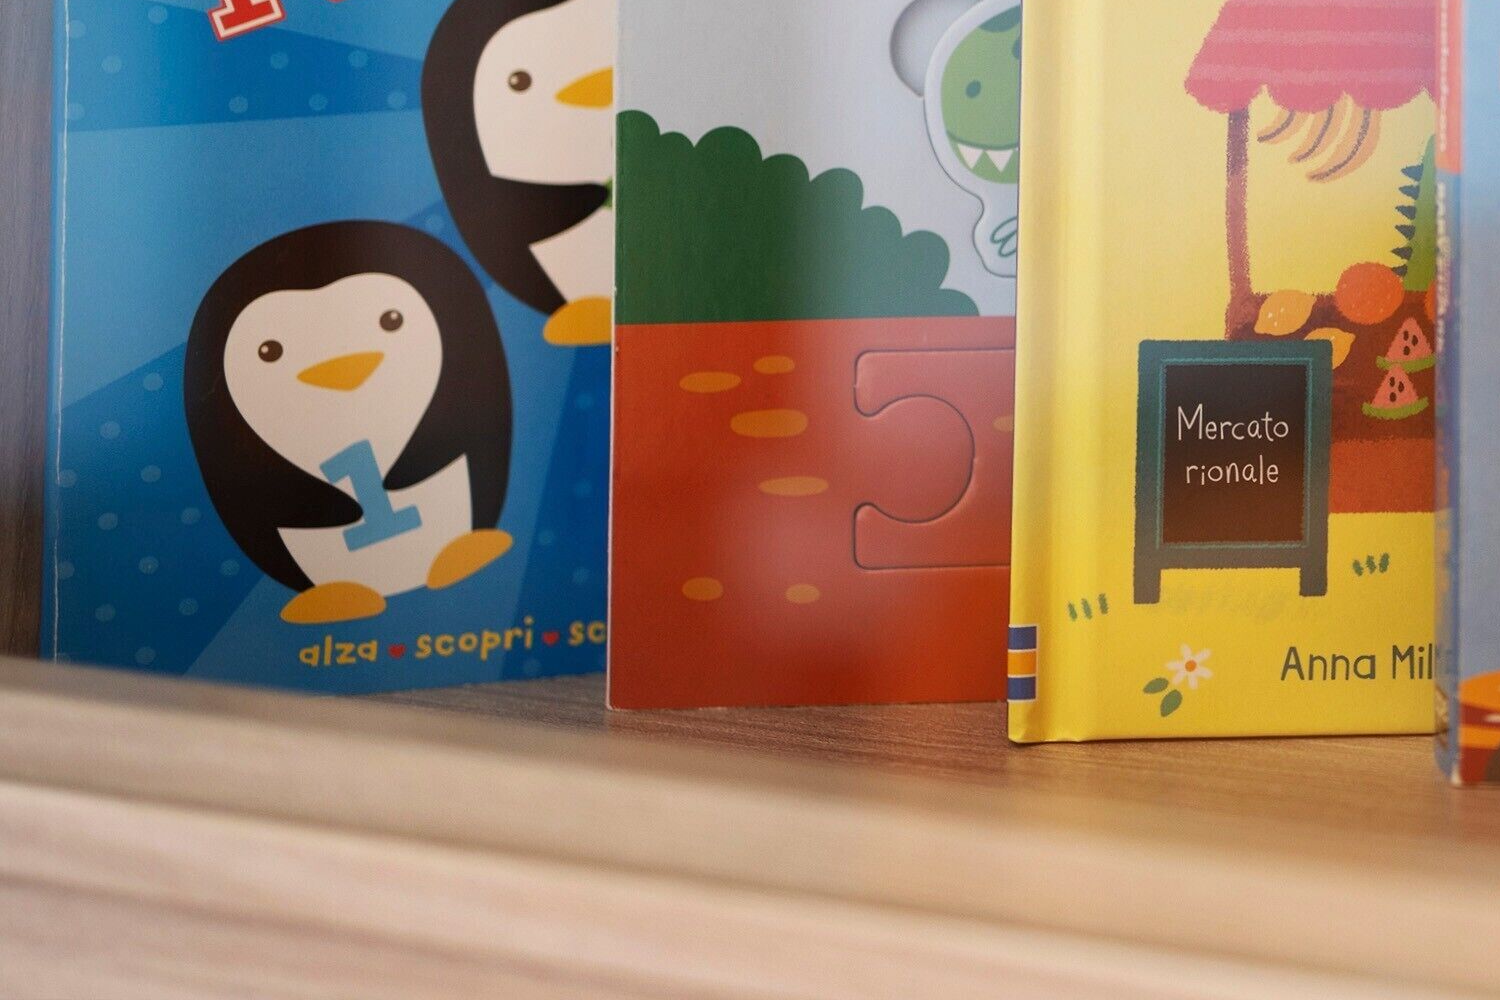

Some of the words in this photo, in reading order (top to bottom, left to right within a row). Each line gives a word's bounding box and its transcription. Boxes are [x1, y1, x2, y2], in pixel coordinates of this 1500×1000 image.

[1177, 403, 1290, 442] Mercato
[1186, 454, 1279, 485] rionale
[299, 634, 379, 667] alza
[414, 614, 534, 661] scopri
[1280, 646, 1377, 681] Anna
